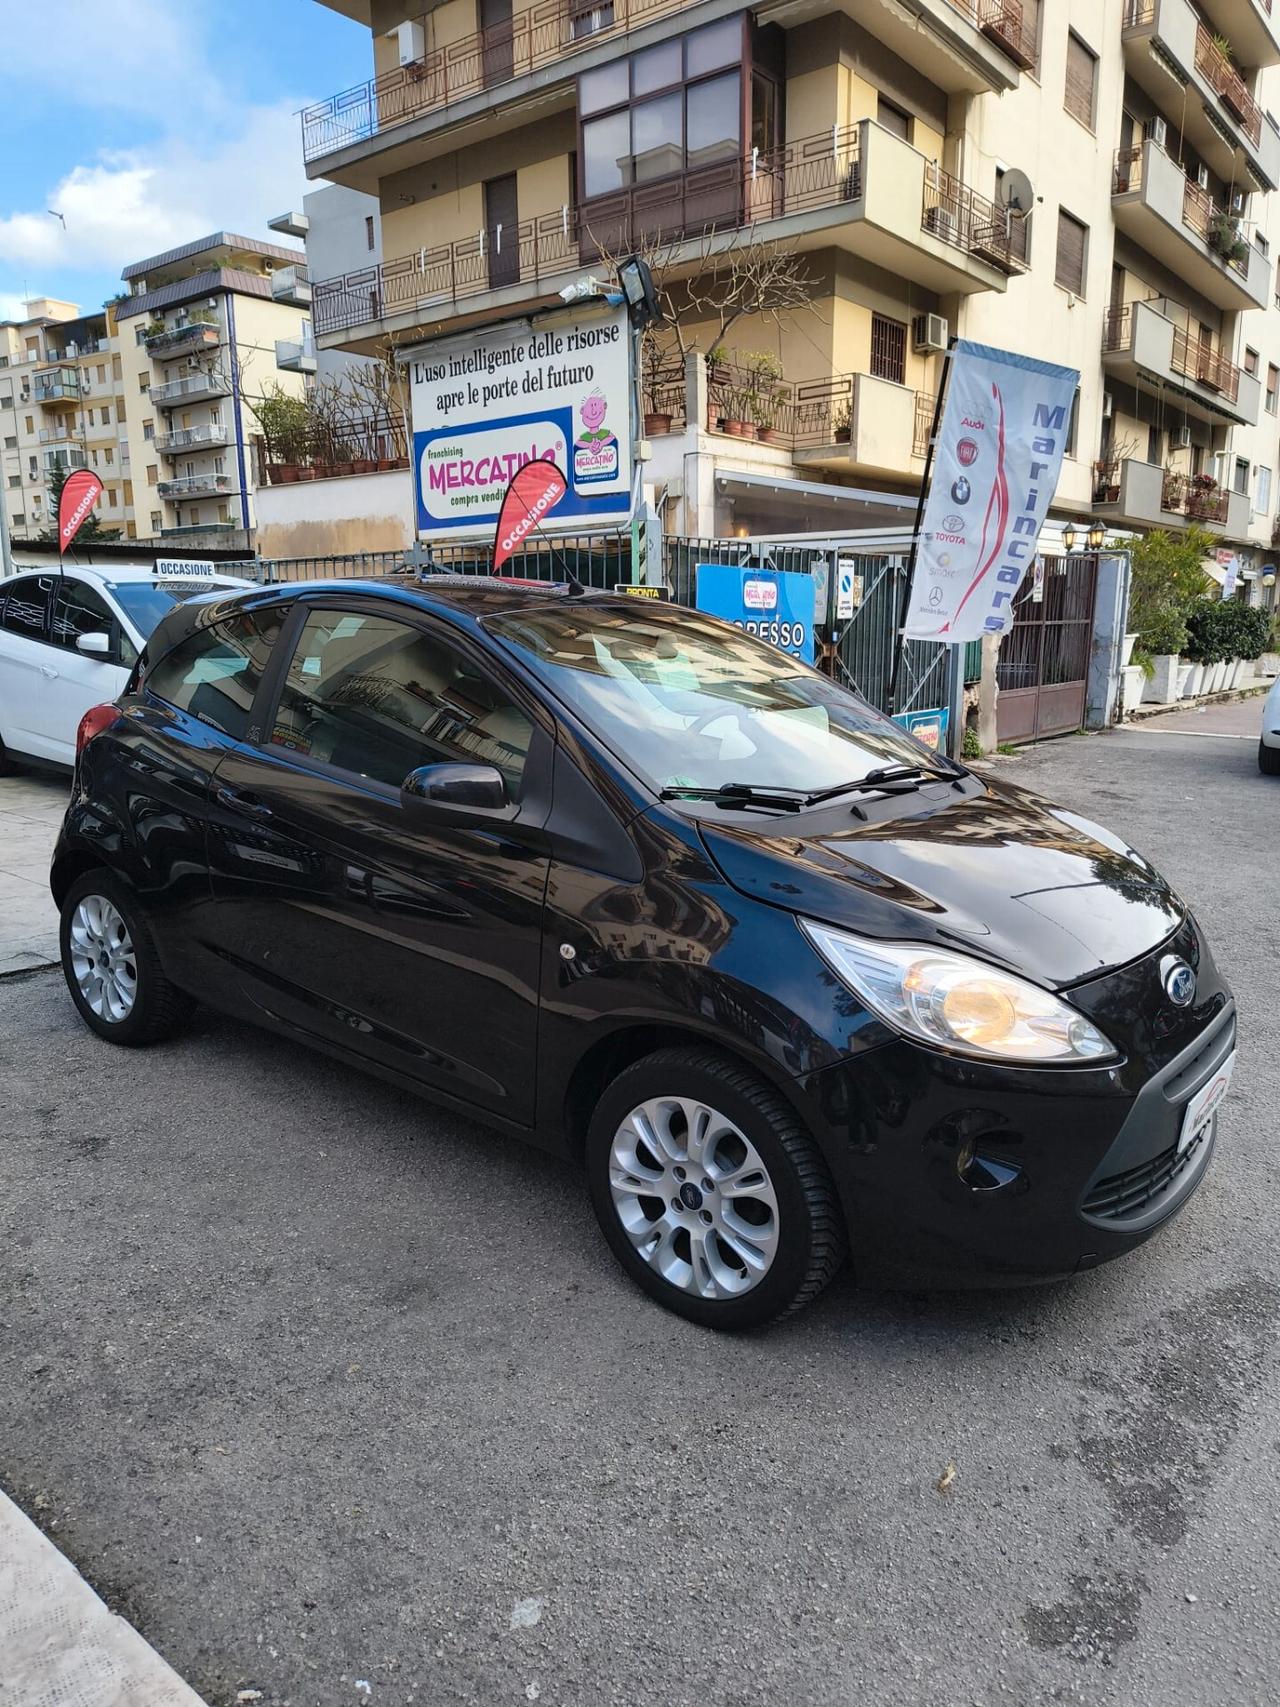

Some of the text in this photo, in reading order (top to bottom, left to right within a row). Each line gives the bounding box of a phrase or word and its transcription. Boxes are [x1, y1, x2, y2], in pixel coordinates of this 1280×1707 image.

[414, 324, 620, 385] L'uso intelligente delle risorse
[436, 363, 594, 414] apre le porte del futuro
[961, 417, 985, 430] Audi
[428, 446, 464, 460] franchising
[576, 452, 614, 467] MERCATINO
[450, 494, 479, 508] compra
[63, 485, 97, 537] OCCASIONE
[502, 482, 560, 550] OCCASIONE
[984, 402, 1066, 631] Marincars
[935, 532, 966, 545] TOYOTA
[160, 562, 213, 576] OCCASIONE
